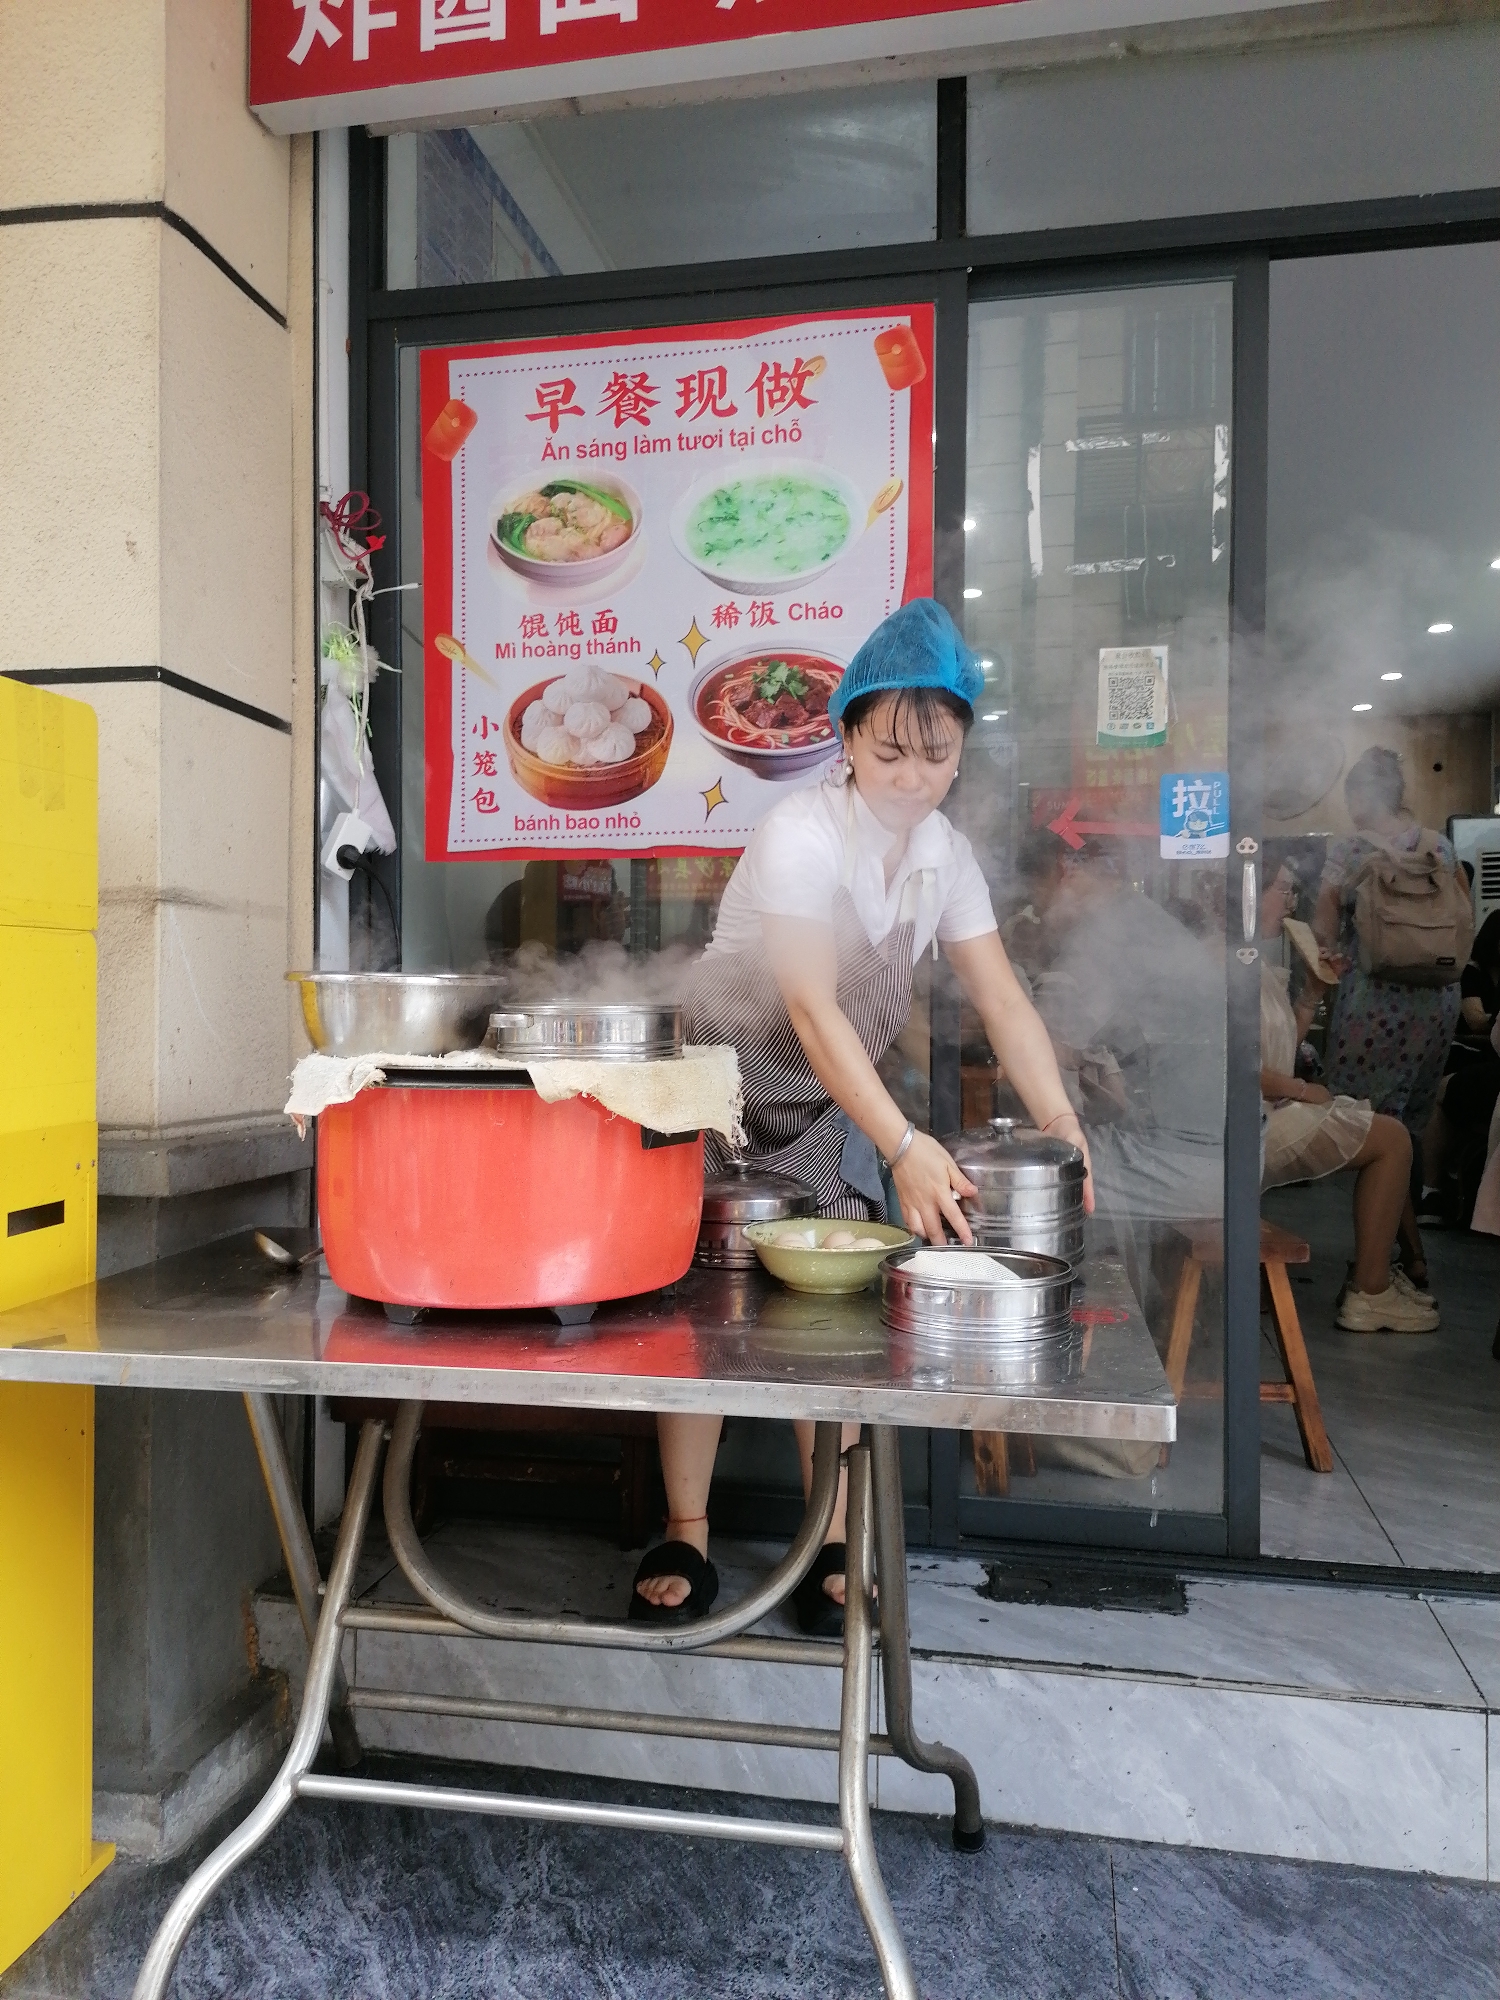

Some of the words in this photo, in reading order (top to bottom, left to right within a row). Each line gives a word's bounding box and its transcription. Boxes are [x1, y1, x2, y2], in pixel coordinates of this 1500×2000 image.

[525, 357, 819, 435] 早餐现做
[541, 437, 570, 461] Ăn
[576, 438, 628, 462] sáng
[633, 434, 672, 455] làm
[677, 429, 723, 451] tươi
[729, 426, 755, 451] tại
[761, 419, 803, 445] chỗ
[517, 608, 619, 640] 馄饨面
[710, 600, 780, 629] 稀饭
[788, 602, 844, 621] Cháo
[495, 642, 516, 659] Mì
[522, 640, 581, 661] hoàng
[586, 637, 641, 655] thánh
[471, 715, 501, 816] 小笼包
[1172, 779, 1212, 817] 拉
[1213, 781, 1222, 815] PULL
[513, 814, 561, 832] bánh
[565, 813, 601, 831] bao
[605, 813, 641, 829] nhỏ
